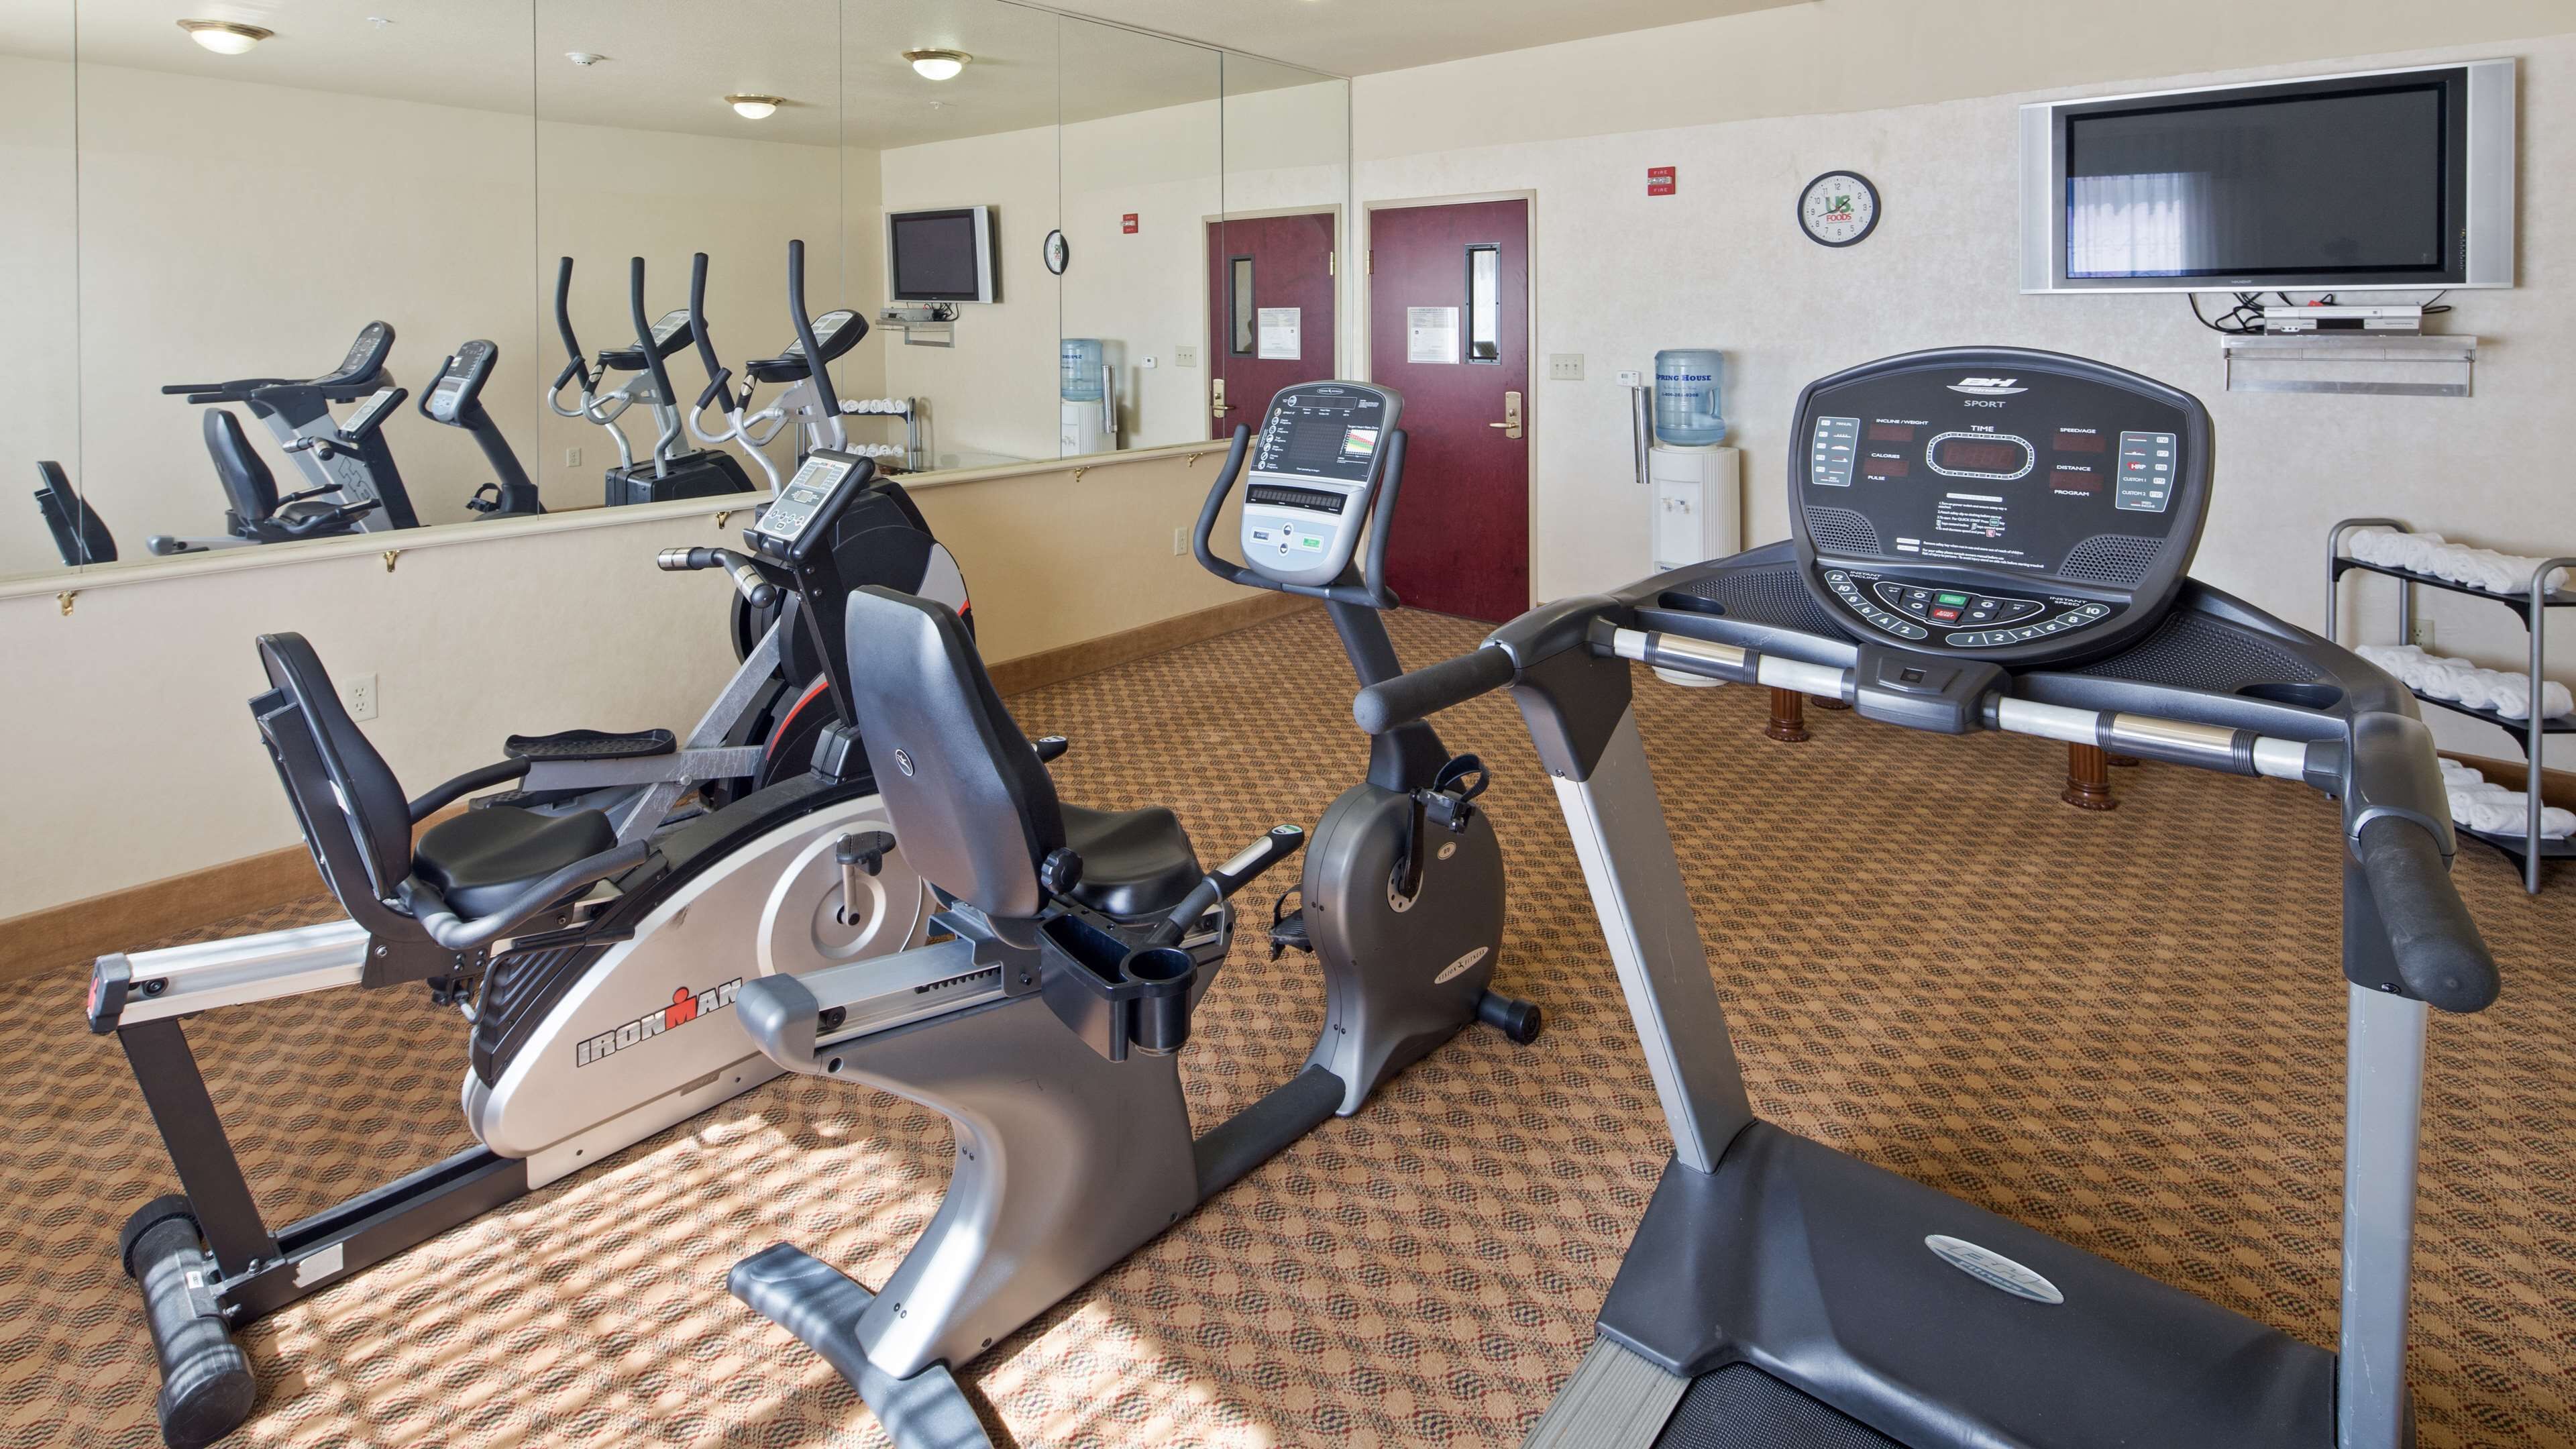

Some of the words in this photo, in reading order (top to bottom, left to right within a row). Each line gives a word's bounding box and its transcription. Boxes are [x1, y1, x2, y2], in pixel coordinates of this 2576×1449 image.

[1826, 213, 1851, 221] FOODS
[1957, 377, 2019, 386] BH
[1964, 400, 2006, 408] SPORT
[1464, 950, 1485, 966] FITNESS
[577, 977, 742, 1068] IRONMAN
